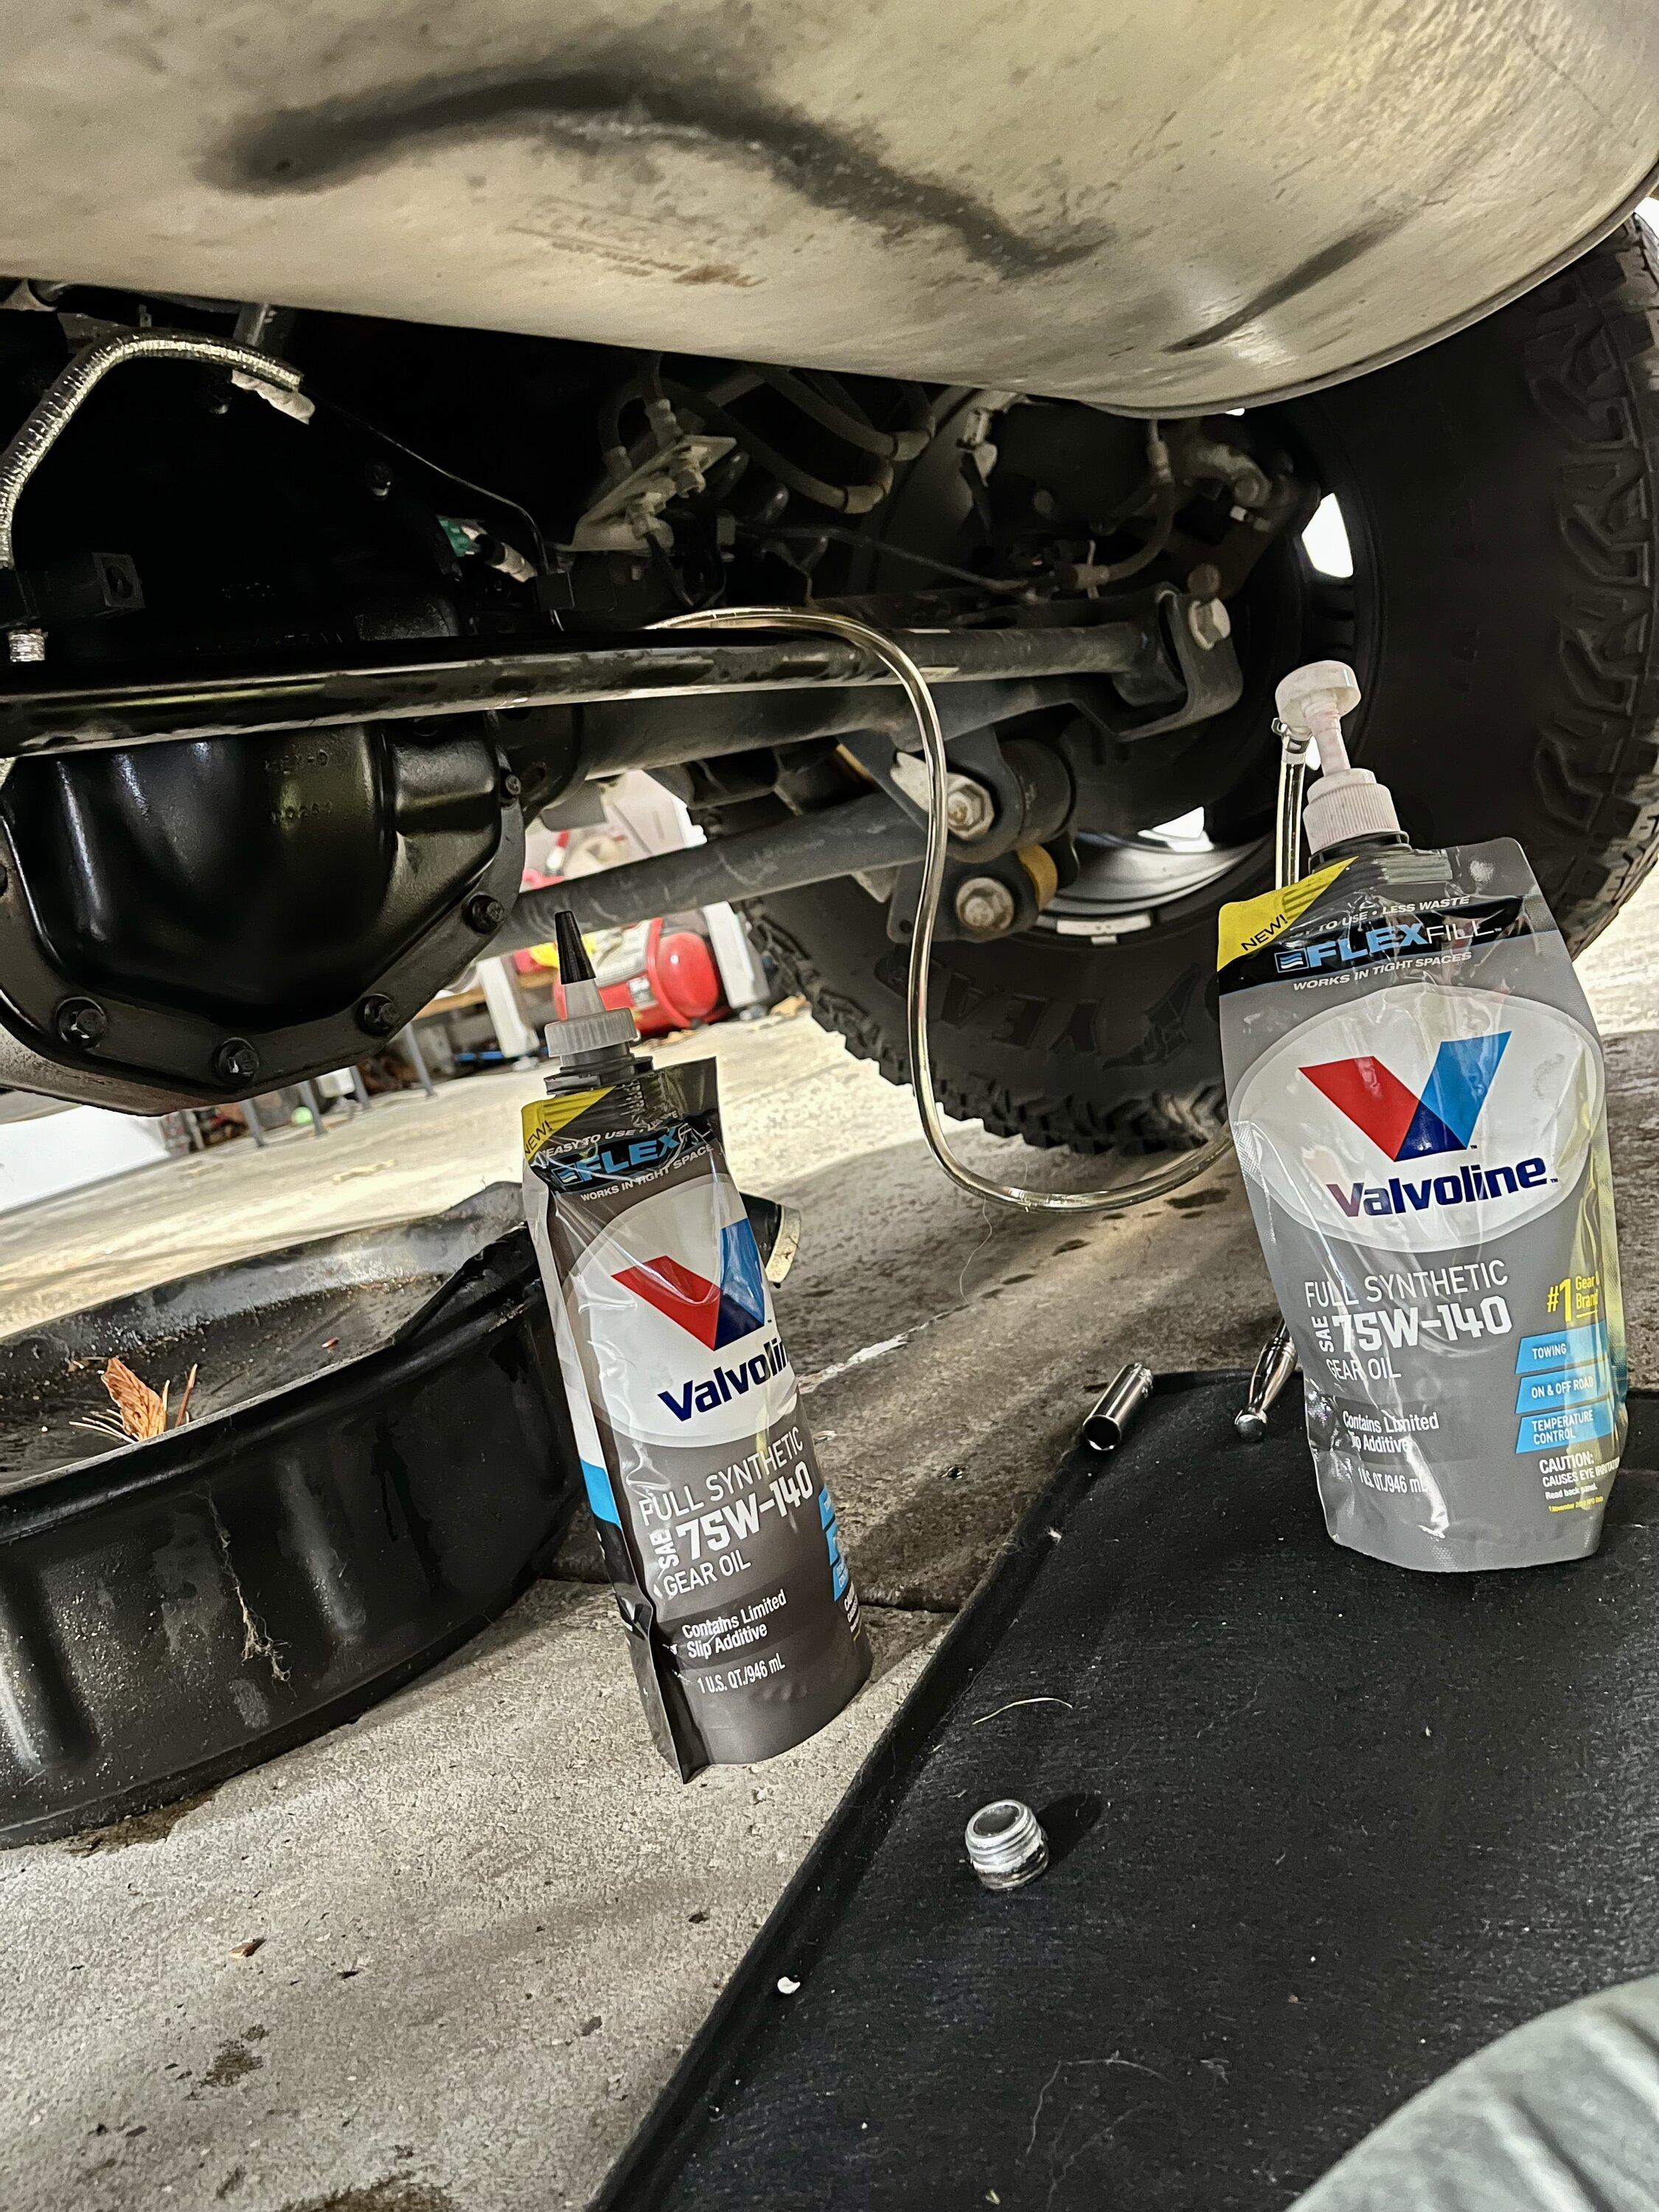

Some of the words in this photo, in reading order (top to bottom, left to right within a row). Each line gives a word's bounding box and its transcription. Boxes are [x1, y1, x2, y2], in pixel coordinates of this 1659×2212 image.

[1318, 920, 1338, 932] TO
[1342, 911, 1368, 926] USE
[1382, 903, 1415, 916] LESS
[1419, 896, 1471, 911] WASTE
[1241, 914, 1288, 952] NEW!
[1293, 974, 1350, 991] WORKS
[1354, 969, 1369, 981] IN
[1372, 959, 1413, 974] TIGHT
[1415, 951, 1472, 967] SPACES
[546, 1141, 580, 1157] EASY
[582, 1133, 600, 1147] TO
[605, 1129, 635, 1140] USE
[580, 1185, 619, 1202] WORKS
[621, 1180, 634, 1192] IN
[1325, 1155, 1548, 1217] Valvoline
[1304, 1280, 1359, 1310] FULL
[1364, 1259, 1509, 1303] SYNTHETIC
[1575, 1276, 1596, 1290] Gear
[1310, 1315, 1335, 1353] SAE
[1330, 1295, 1513, 1353] 75W-140
[1326, 1358, 1363, 1382] GEAR
[1368, 1356, 1402, 1380] OIL
[1532, 1343, 1567, 1360] TOWING
[1531, 1386, 1545, 1399] ON
[1546, 1384, 1554, 1396] &
[1556, 1380, 1572, 1394] OFF
[1573, 1376, 1594, 1391] ROAD
[1343, 1411, 1382, 1433] Contains
[1531, 1409, 1593, 1432] TEMPERATURE
[1534, 1427, 1576, 1445] CONTROL
[1363, 1433, 1409, 1453] Additive
[638, 1484, 705, 1526] FULL
[706, 1426, 804, 1502] SYNTHETIC
[1539, 1450, 1595, 1474] CAUTION:
[1543, 1471, 1579, 1487] CAUSES
[1579, 1468, 1595, 1481] EYE
[676, 1459, 814, 1561] 75W-140
[649, 1528, 679, 1571] SAE
[664, 1565, 718, 1599] GEAR
[719, 1549, 751, 1577] OIL
[682, 1613, 740, 1639] Contains
[741, 1588, 787, 1624] Limited
[686, 1637, 711, 1661] Slip
[715, 1621, 768, 1653] Additive
[698, 1677, 704, 1694] 1
[706, 1672, 728, 1693] U.S.
[768, 1652, 785, 1674] mL
